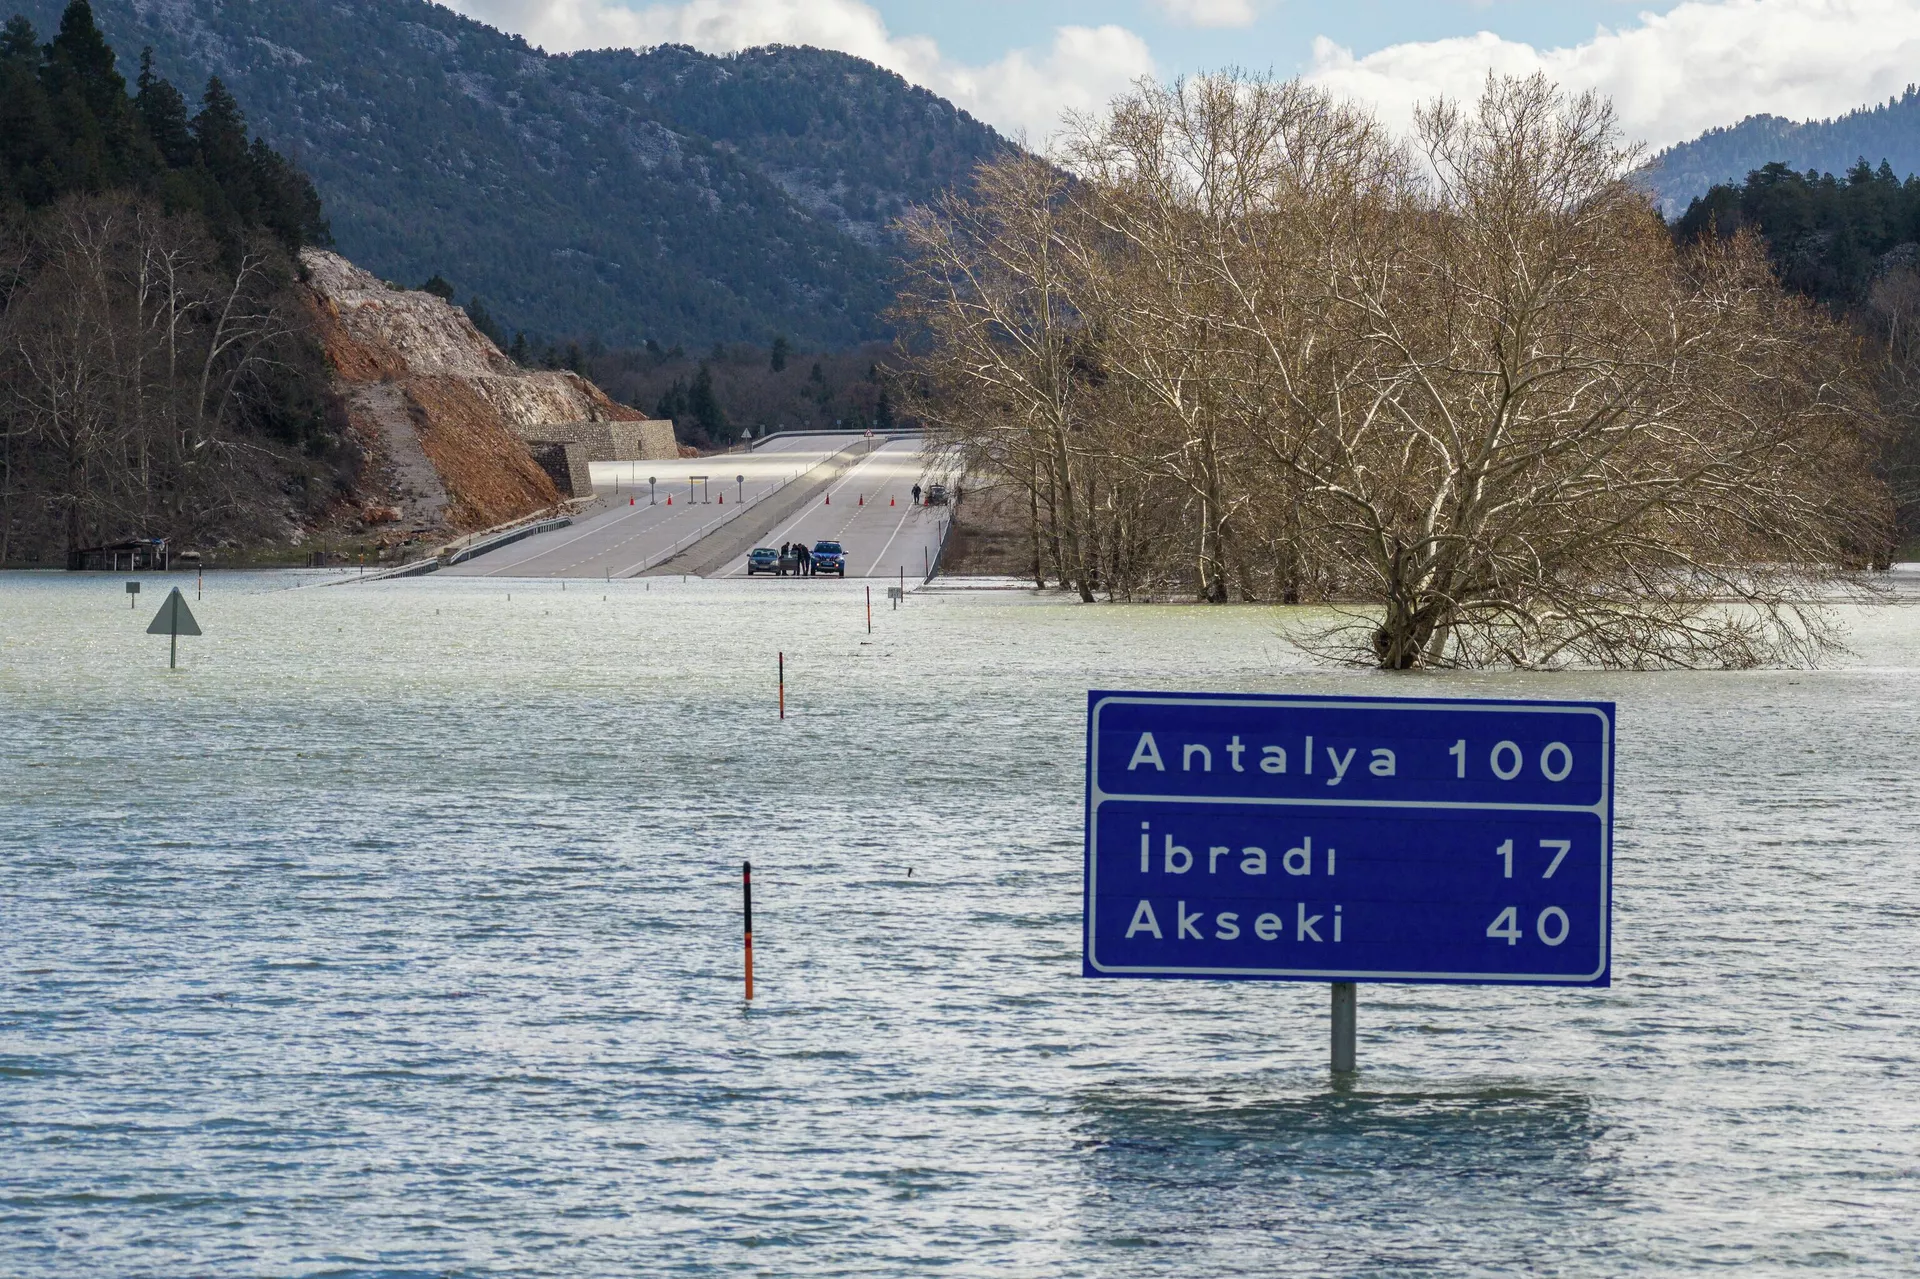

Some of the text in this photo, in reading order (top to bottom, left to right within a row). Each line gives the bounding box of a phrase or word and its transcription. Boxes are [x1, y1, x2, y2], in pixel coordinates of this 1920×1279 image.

[1127, 731, 1573, 786] Antalya 100
[1140, 821, 1571, 879] İbradı 17
[1125, 899, 1570, 947] Akseki 40
